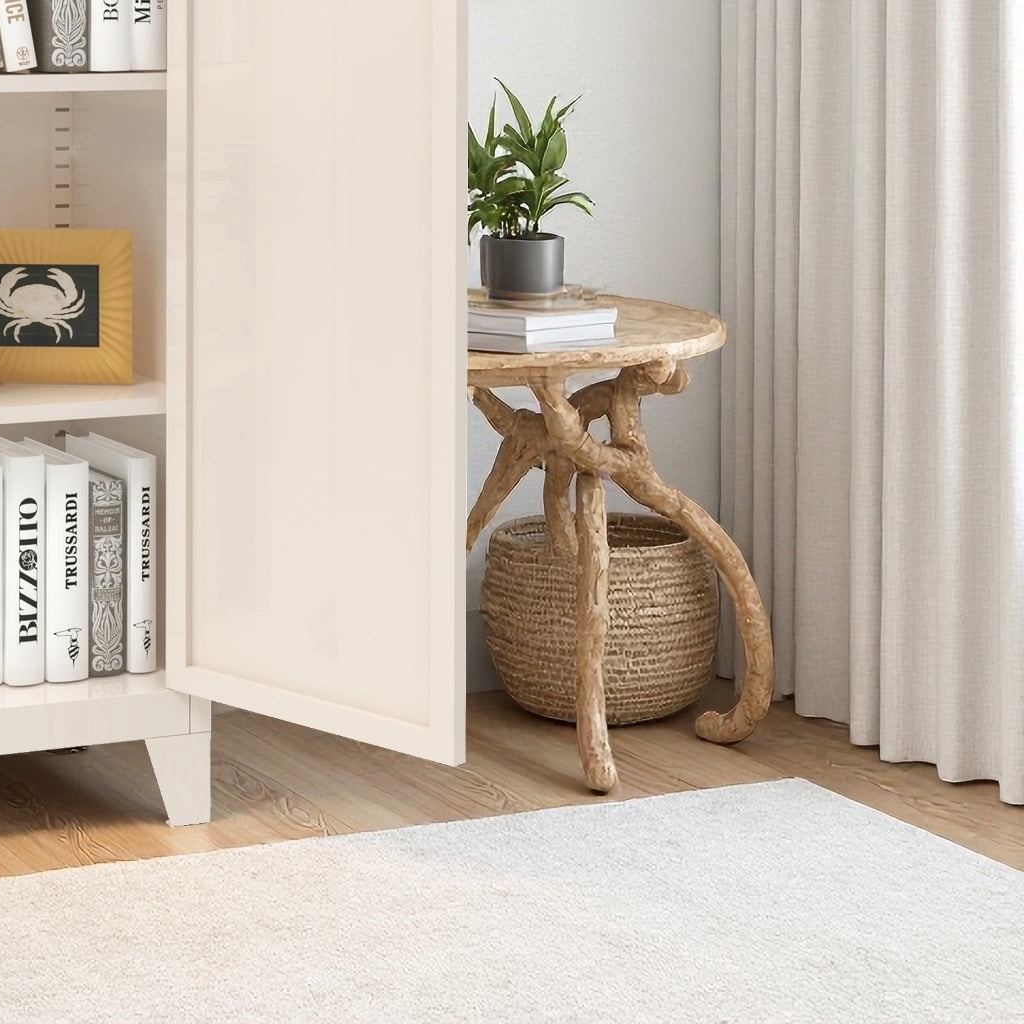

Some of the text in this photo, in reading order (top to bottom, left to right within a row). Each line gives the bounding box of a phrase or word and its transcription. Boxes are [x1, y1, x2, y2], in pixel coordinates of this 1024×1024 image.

[65, 492, 78, 590] TRUSSARDI
[94, 507, 120, 516] MEMOIR
[142, 486, 150, 582] TRUSSARDI
